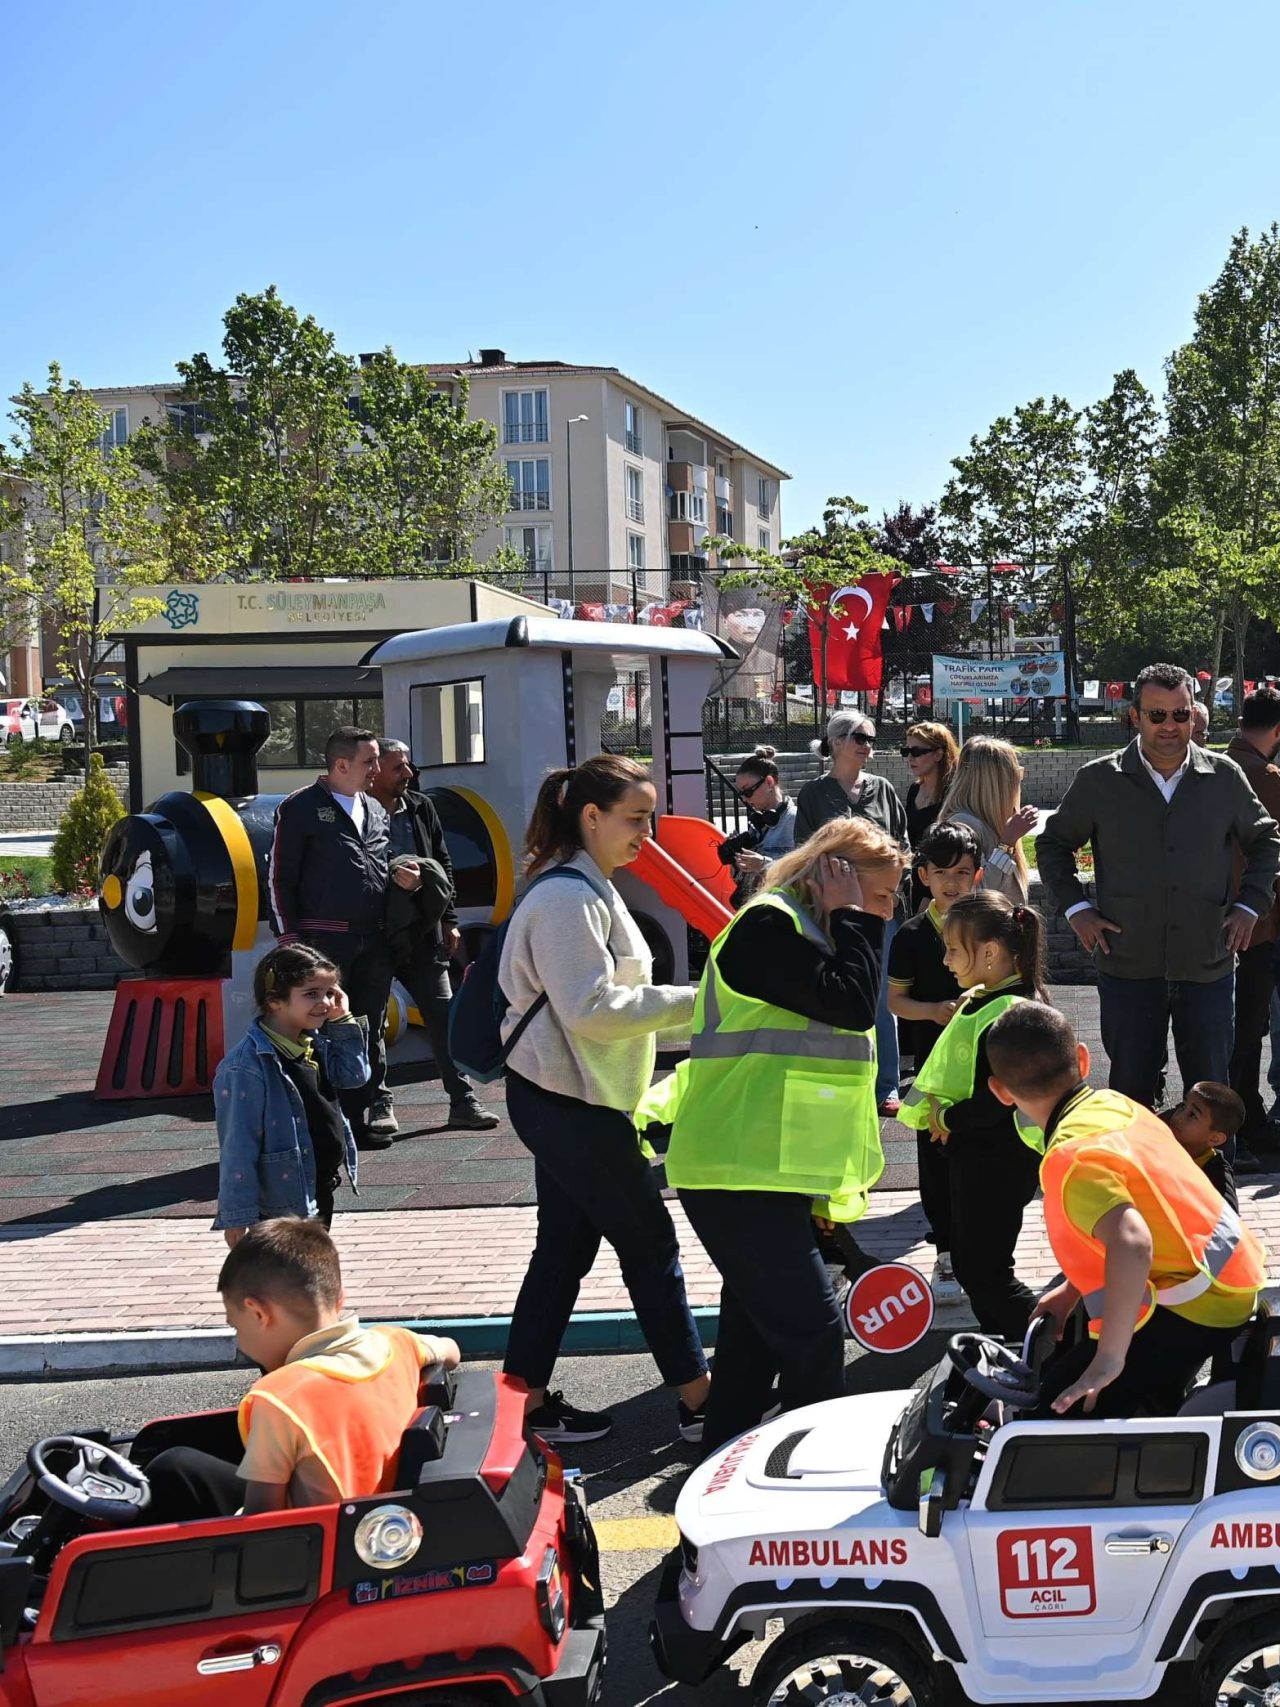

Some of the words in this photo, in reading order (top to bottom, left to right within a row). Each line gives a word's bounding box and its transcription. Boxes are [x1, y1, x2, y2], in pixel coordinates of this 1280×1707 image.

[237, 595, 262, 610] T.C.
[266, 590, 386, 613] SÜLEYMANPAŞA
[288, 609, 367, 622] BELEDİYESİ
[944, 664, 976, 673] TRAFİK
[856, 1280, 925, 1334] DUR
[749, 1539, 908, 1566] AMBULANS
[1011, 1537, 1079, 1581] 112
[1030, 1589, 1067, 1603] ACİL
[1034, 1603, 1064, 1611] ÇAĞRI
